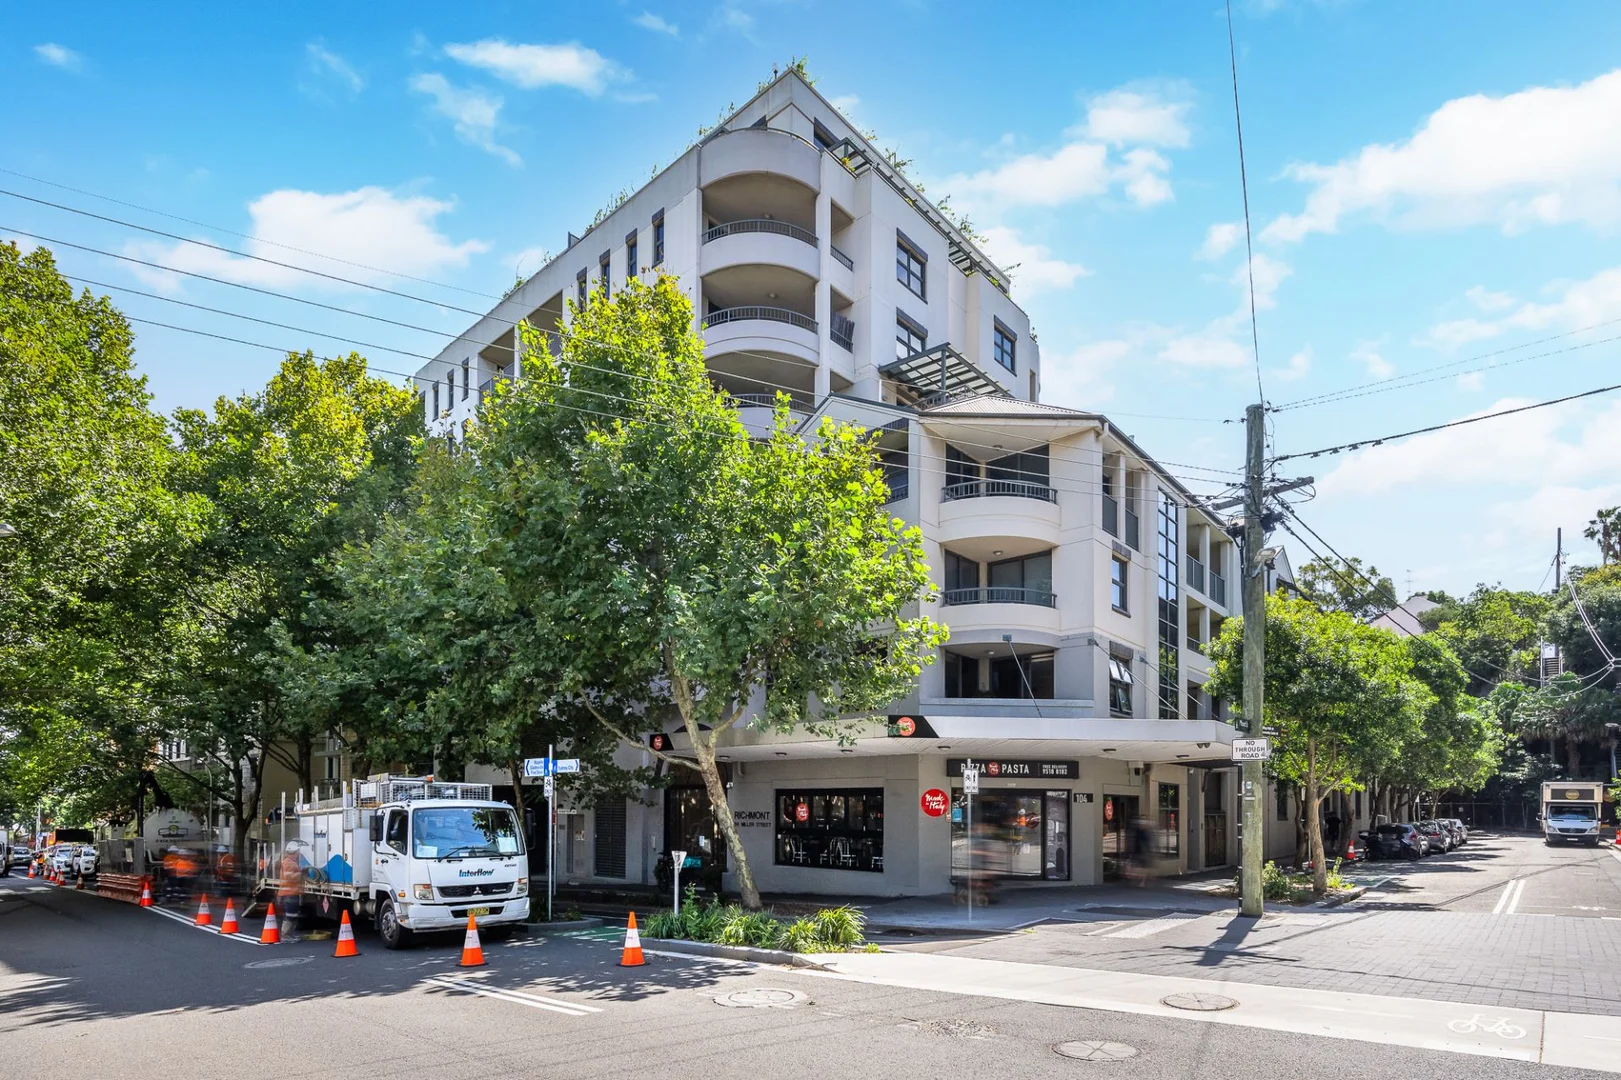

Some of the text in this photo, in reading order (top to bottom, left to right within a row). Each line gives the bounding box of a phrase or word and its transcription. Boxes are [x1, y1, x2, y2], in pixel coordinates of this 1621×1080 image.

[1001, 763, 1030, 774] PASTA
[925, 793, 945, 802] Made
[1076, 794, 1088, 803] 104
[929, 801, 945, 815] Italy
[734, 811, 771, 820] RICHMONT
[458, 868, 494, 878] Interflow
